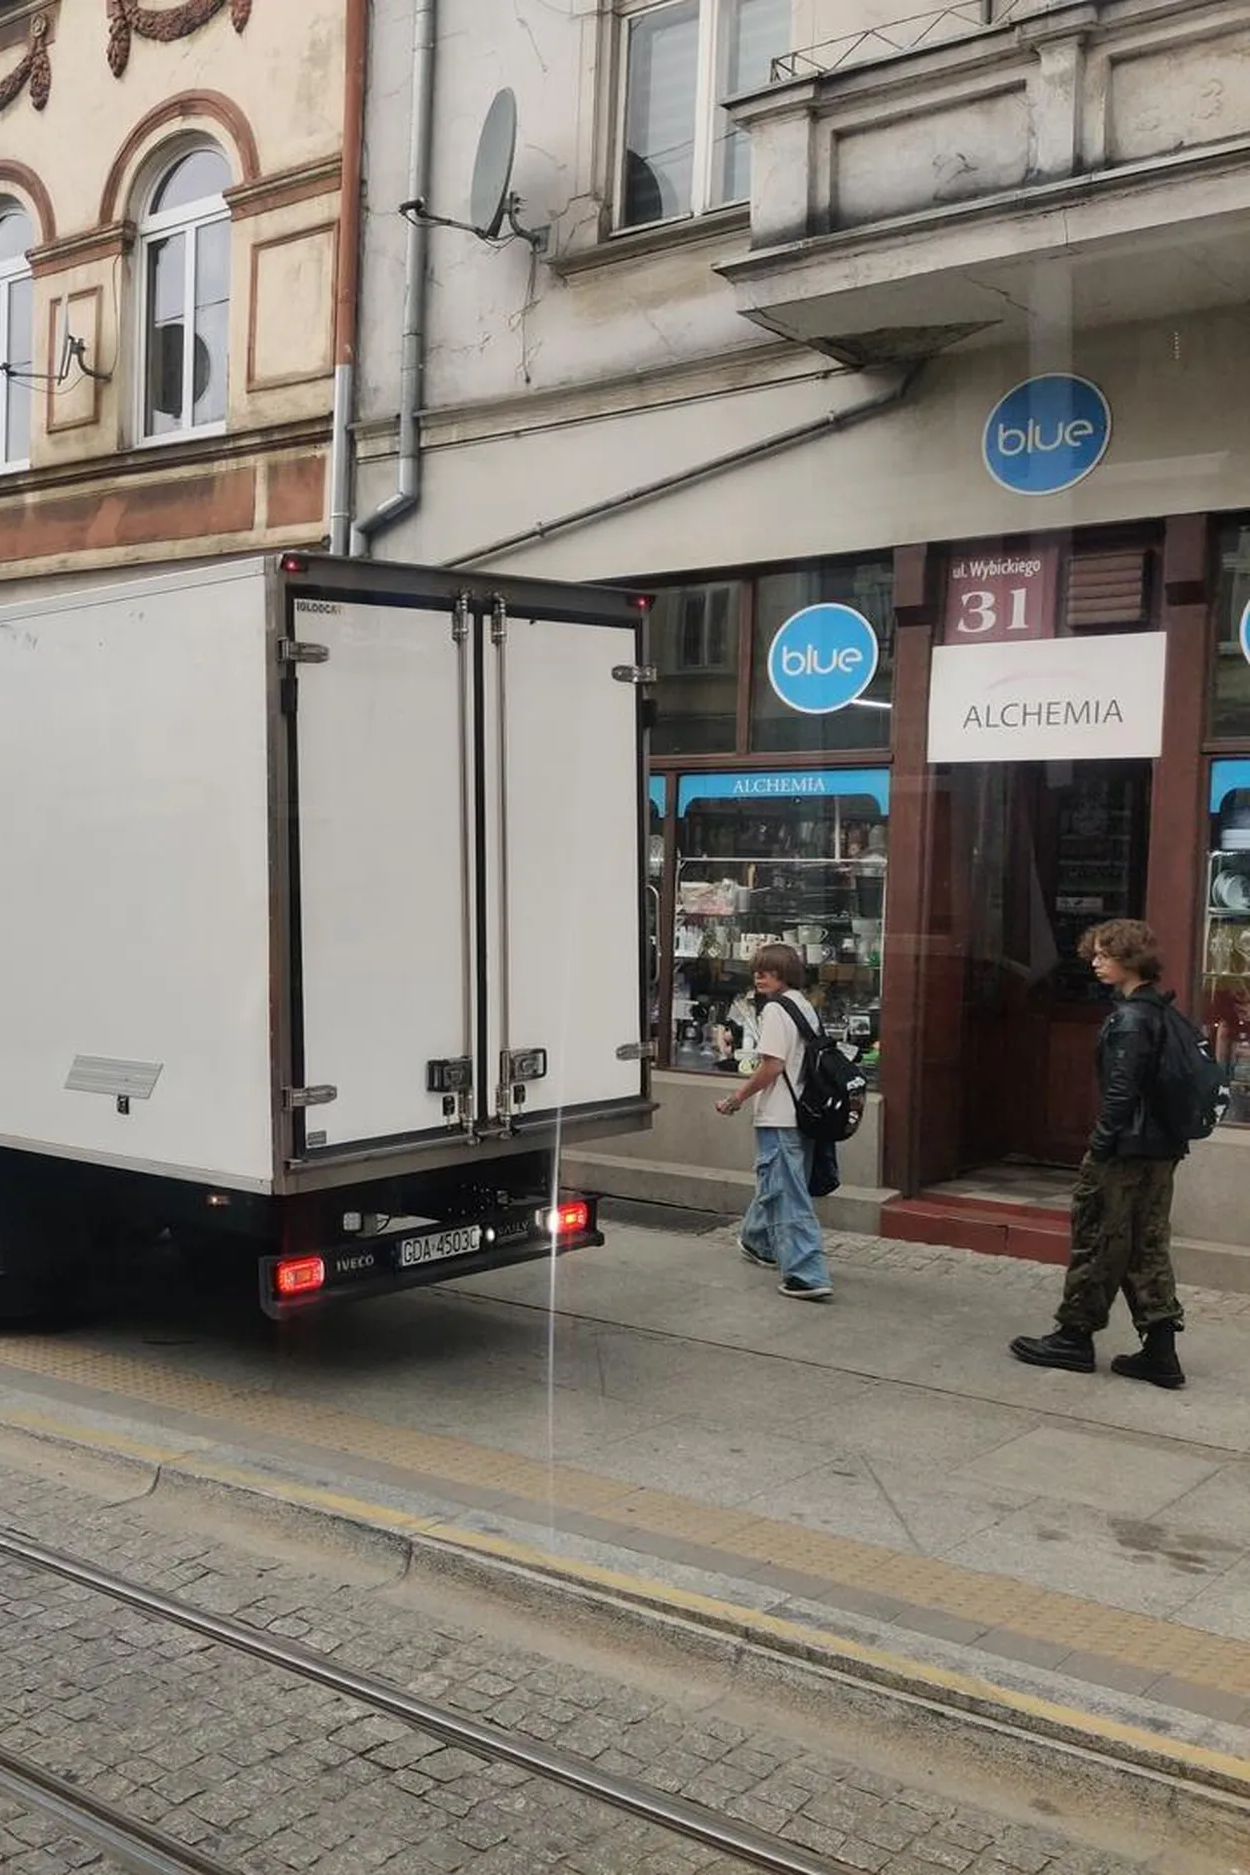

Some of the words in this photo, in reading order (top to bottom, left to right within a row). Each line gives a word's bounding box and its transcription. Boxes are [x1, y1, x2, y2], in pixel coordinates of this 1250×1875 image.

[997, 418, 1094, 456] blue
[952, 563, 968, 579] ul.
[969, 557, 1042, 582] Wybickiego
[957, 587, 1029, 633] 31
[781, 643, 863, 676] blue
[962, 699, 1124, 729] ALCHEMIA
[733, 776, 826, 794] ALCHEMIA
[335, 1254, 374, 1272] IVECO
[404, 1238, 431, 1263] GDA
